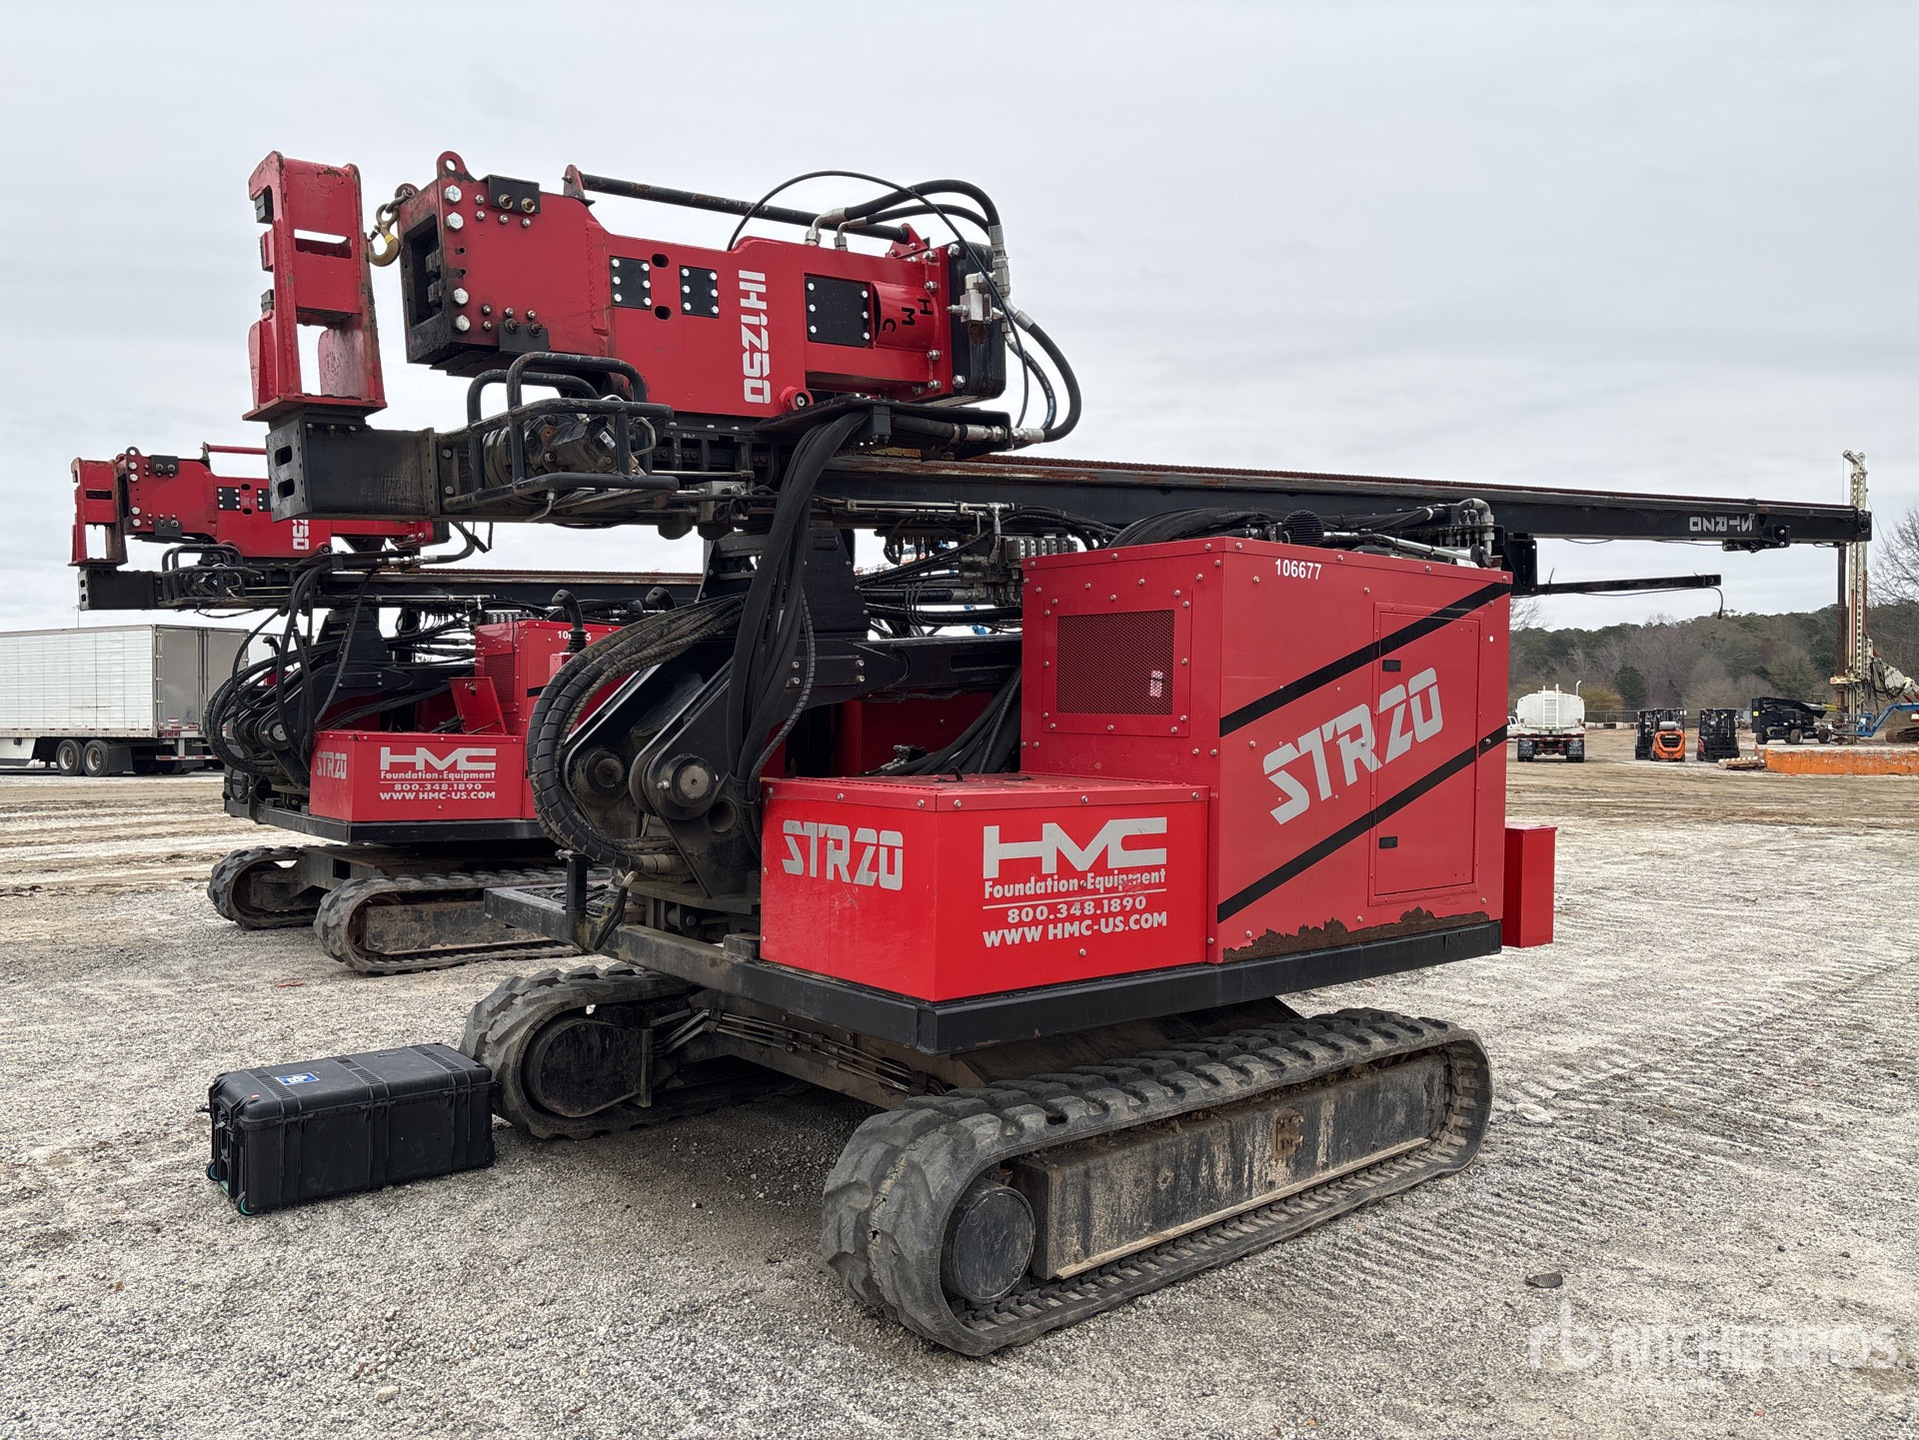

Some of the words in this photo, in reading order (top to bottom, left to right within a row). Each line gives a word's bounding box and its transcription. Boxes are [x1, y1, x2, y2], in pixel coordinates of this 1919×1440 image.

[1275, 558, 1321, 580] 106677
[380, 747, 497, 770] HMC
[1262, 667, 1444, 825] STR20
[379, 792, 415, 800] WWW
[419, 791, 496, 800] HMC-US.COM
[394, 783, 482, 791] 800.348.1890
[781, 819, 904, 891] STR20
[983, 817, 1167, 879] HMC
[1007, 896, 1146, 924] 800.348.1890
[983, 925, 1044, 948] WWW
[1047, 911, 1167, 940] HMC-US.COM
